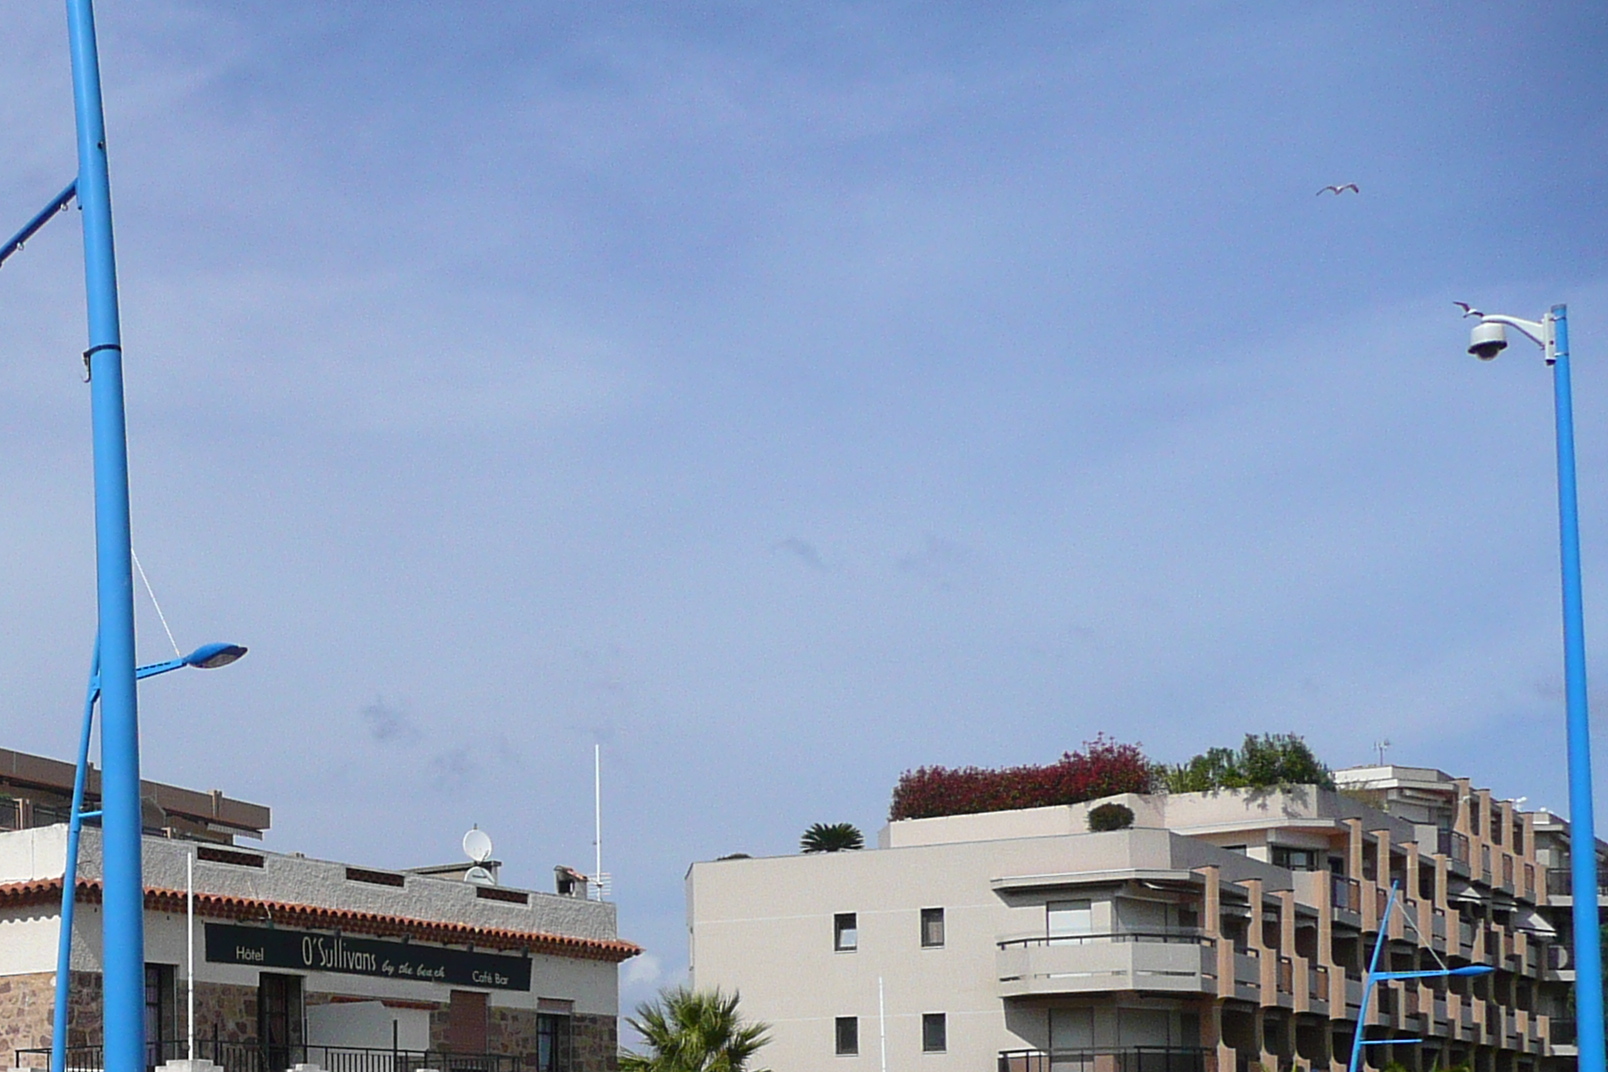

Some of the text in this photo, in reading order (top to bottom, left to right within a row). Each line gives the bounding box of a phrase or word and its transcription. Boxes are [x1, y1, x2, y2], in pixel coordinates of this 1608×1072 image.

[236, 945, 264, 961] Hôtel
[302, 936, 376, 971] O'Sullivans
[381, 960, 395, 976] by
[398, 962, 413, 975] the
[494, 973, 510, 985] Bar
